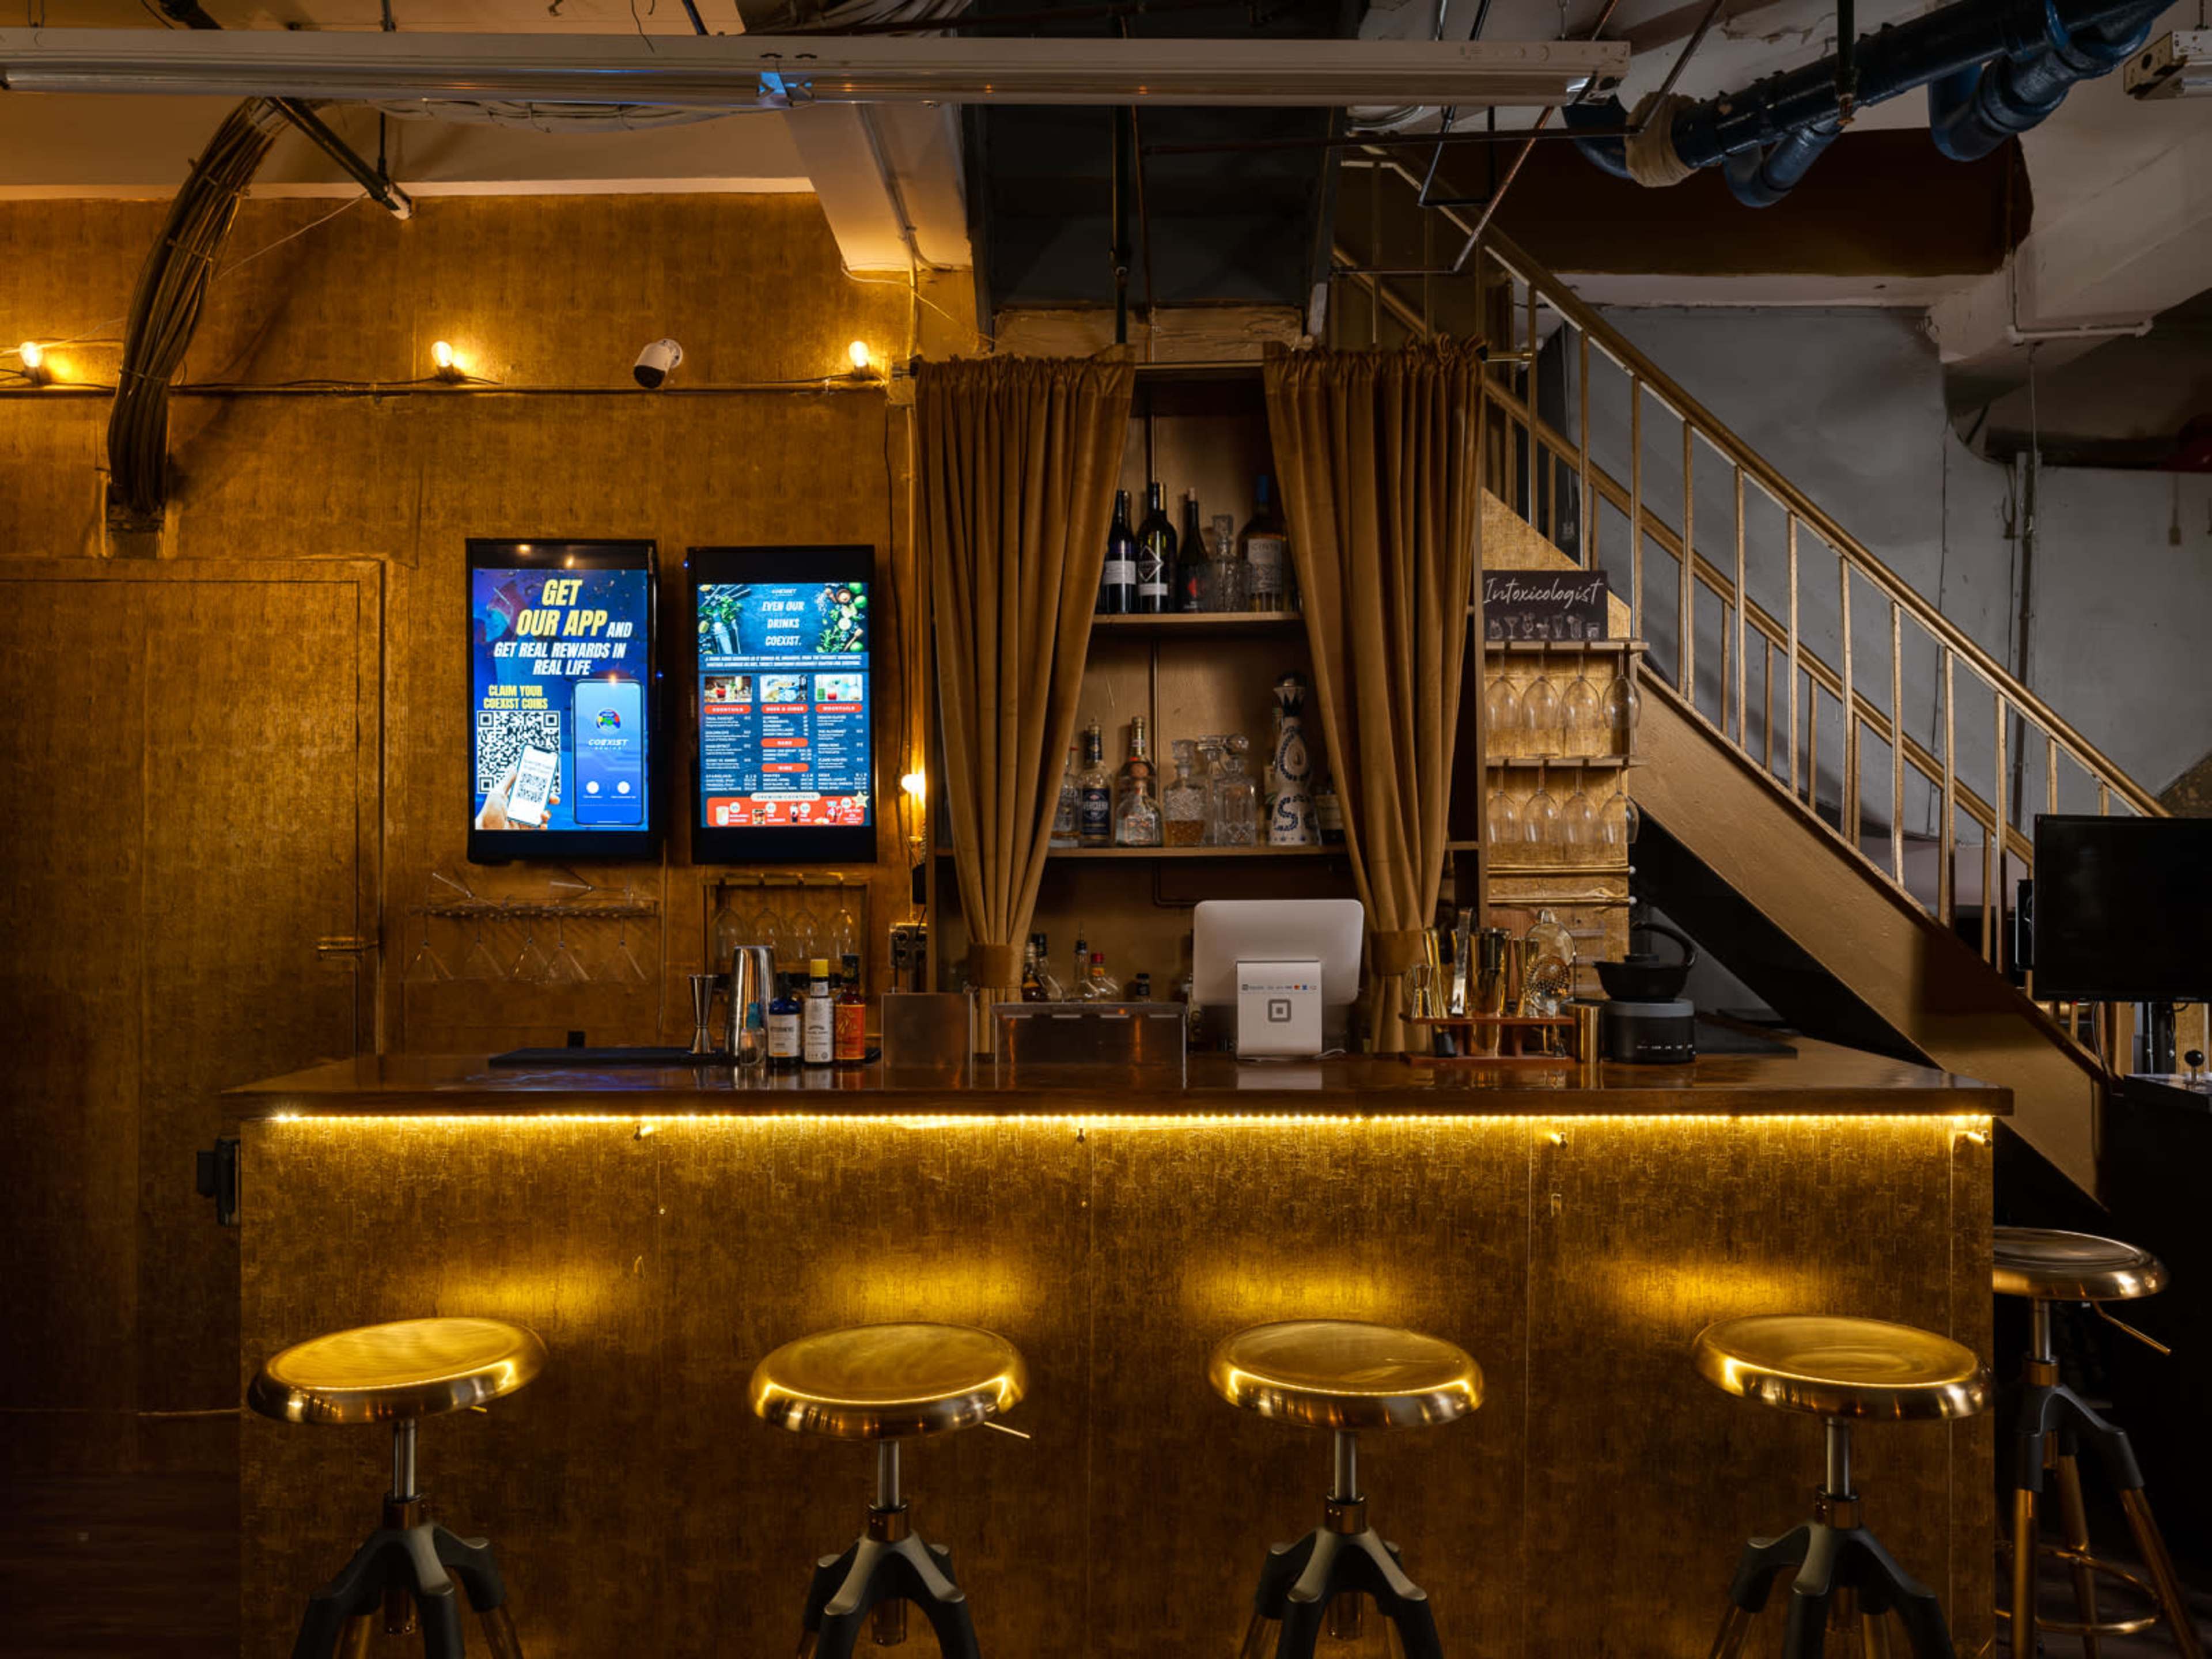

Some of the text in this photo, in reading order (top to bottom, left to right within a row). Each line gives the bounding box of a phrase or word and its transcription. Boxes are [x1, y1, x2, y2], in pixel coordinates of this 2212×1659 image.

[541, 579, 582, 606] GET
[1483, 577, 1604, 609] Intoxicologist
[762, 601, 805, 611] EVEN OUR
[516, 609, 632, 638] OUR APP AND
[767, 618, 800, 628] DRINKS
[765, 635, 802, 646] COEXIST.
[494, 642, 627, 658] GET REAL REWARDS IN
[533, 660, 592, 675] REAL LIFE
[488, 685, 543, 696] CLAIM YOUR
